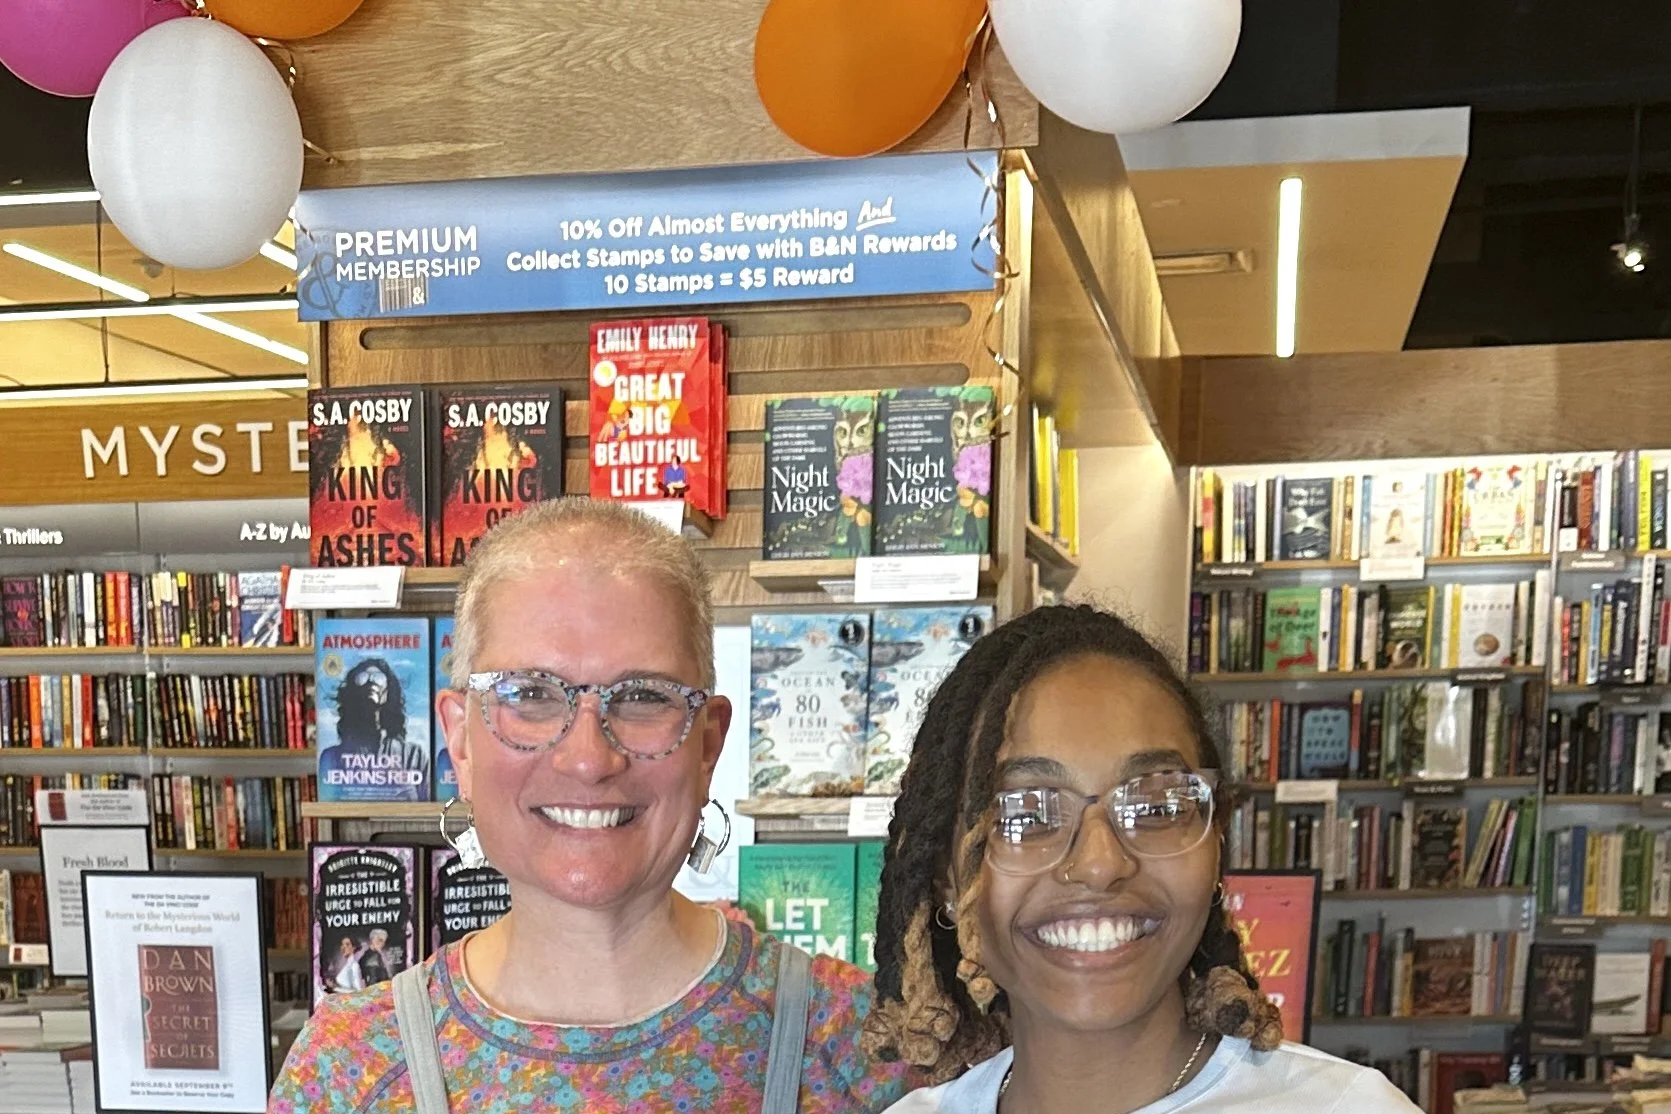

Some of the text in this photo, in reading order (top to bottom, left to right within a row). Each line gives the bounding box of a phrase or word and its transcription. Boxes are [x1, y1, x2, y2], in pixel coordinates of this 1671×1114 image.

[560, 197, 895, 241] 10% Off Almost Everything And
[335, 225, 478, 257] PREMIUM
[506, 229, 957, 272] Collect Stamps to Save with B&N Rewards
[336, 255, 480, 282] MEMBERSHIP
[605, 274, 629, 295] 10
[635, 270, 714, 295] Stamps
[739, 267, 767, 290] $5
[773, 263, 854, 287] Reward
[597, 323, 698, 353] EMILY HENRY
[614, 372, 685, 402] GREAT
[349, 398, 412, 424] COSBY
[485, 400, 550, 426] COSBY
[629, 405, 671, 436] BIG
[595, 438, 701, 467] BEAUTIFUL
[771, 463, 829, 494] Night
[886, 454, 945, 485] Night
[328, 465, 401, 501] KING
[463, 467, 538, 504] KING
[610, 467, 658, 497] LIFE
[770, 488, 836, 518] Magic
[885, 482, 952, 510] Magic
[351, 505, 378, 528] OF
[3, 527, 63, 545] Thrillers
[270, 522, 288, 543] by
[317, 533, 417, 567] ASHES
[322, 634, 421, 649] ATMOSPHERE
[781, 676, 836, 688] OCEAN
[795, 694, 820, 714] 80
[788, 716, 828, 729] FISH
[342, 754, 401, 769] TAYLOR
[322, 769, 423, 785] JENKINS REID
[62, 856, 129, 868] Fresh Blood
[325, 878, 400, 896] IRRESISTIBLE
[782, 881, 810, 894] THE
[325, 898, 351, 911] URGE
[363, 895, 387, 910] FALL
[444, 902, 470, 915] URGE
[766, 898, 829, 931] LET
[105, 910, 134, 920] Return
[136, 911, 145, 920] to
[147, 911, 161, 920] the
[213, 912, 241, 922] World
[326, 910, 400, 928] YOUR ENEMY
[445, 915, 478, 931] YOUR
[143, 948, 213, 971] DAN
[144, 975, 214, 996] BROWN
[153, 1015, 210, 1031] SECRET
[150, 1043, 215, 1059] SECRETS
